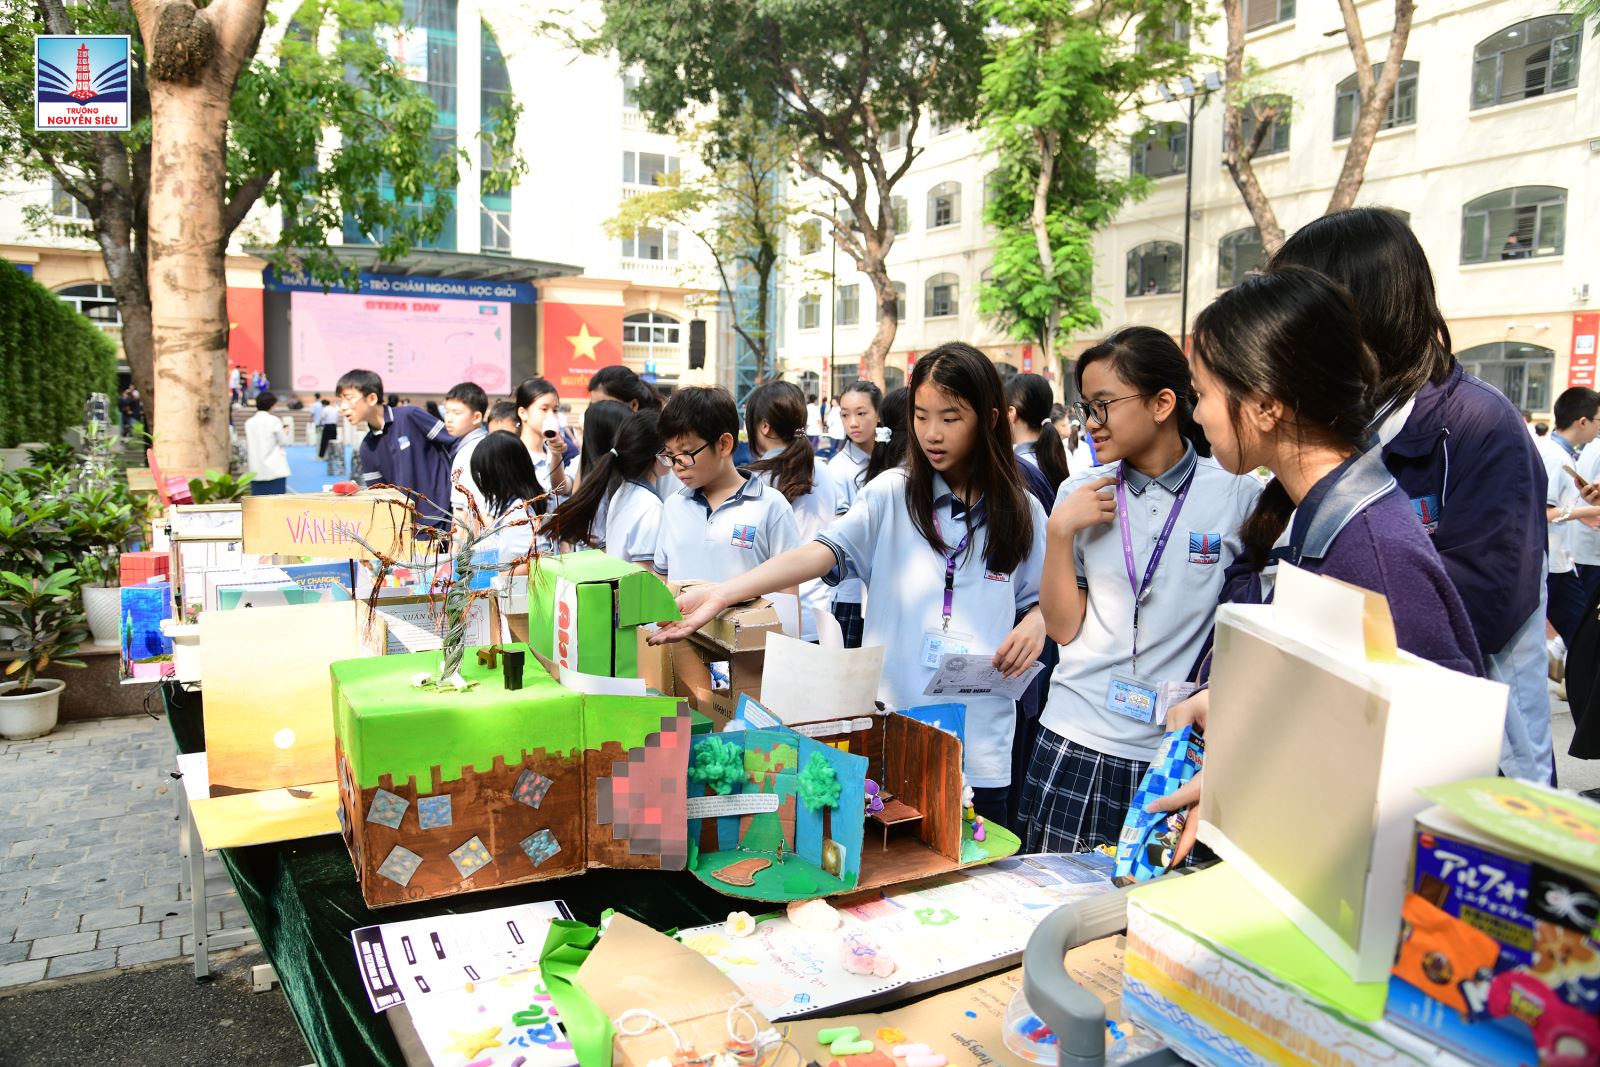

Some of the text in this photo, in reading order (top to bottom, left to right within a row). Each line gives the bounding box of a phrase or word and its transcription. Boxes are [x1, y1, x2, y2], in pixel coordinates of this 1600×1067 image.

[370, 277, 390, 291] TRÒ
[426, 283, 468, 296] NGOAN,
[469, 286, 492, 298] HỌC
[494, 284, 517, 297] GIỎI
[365, 301, 441, 312] STEM DAY
[286, 510, 327, 545] VĂN
[1186, 747, 1204, 766] Oish
[1433, 849, 1530, 903] アルフォー
